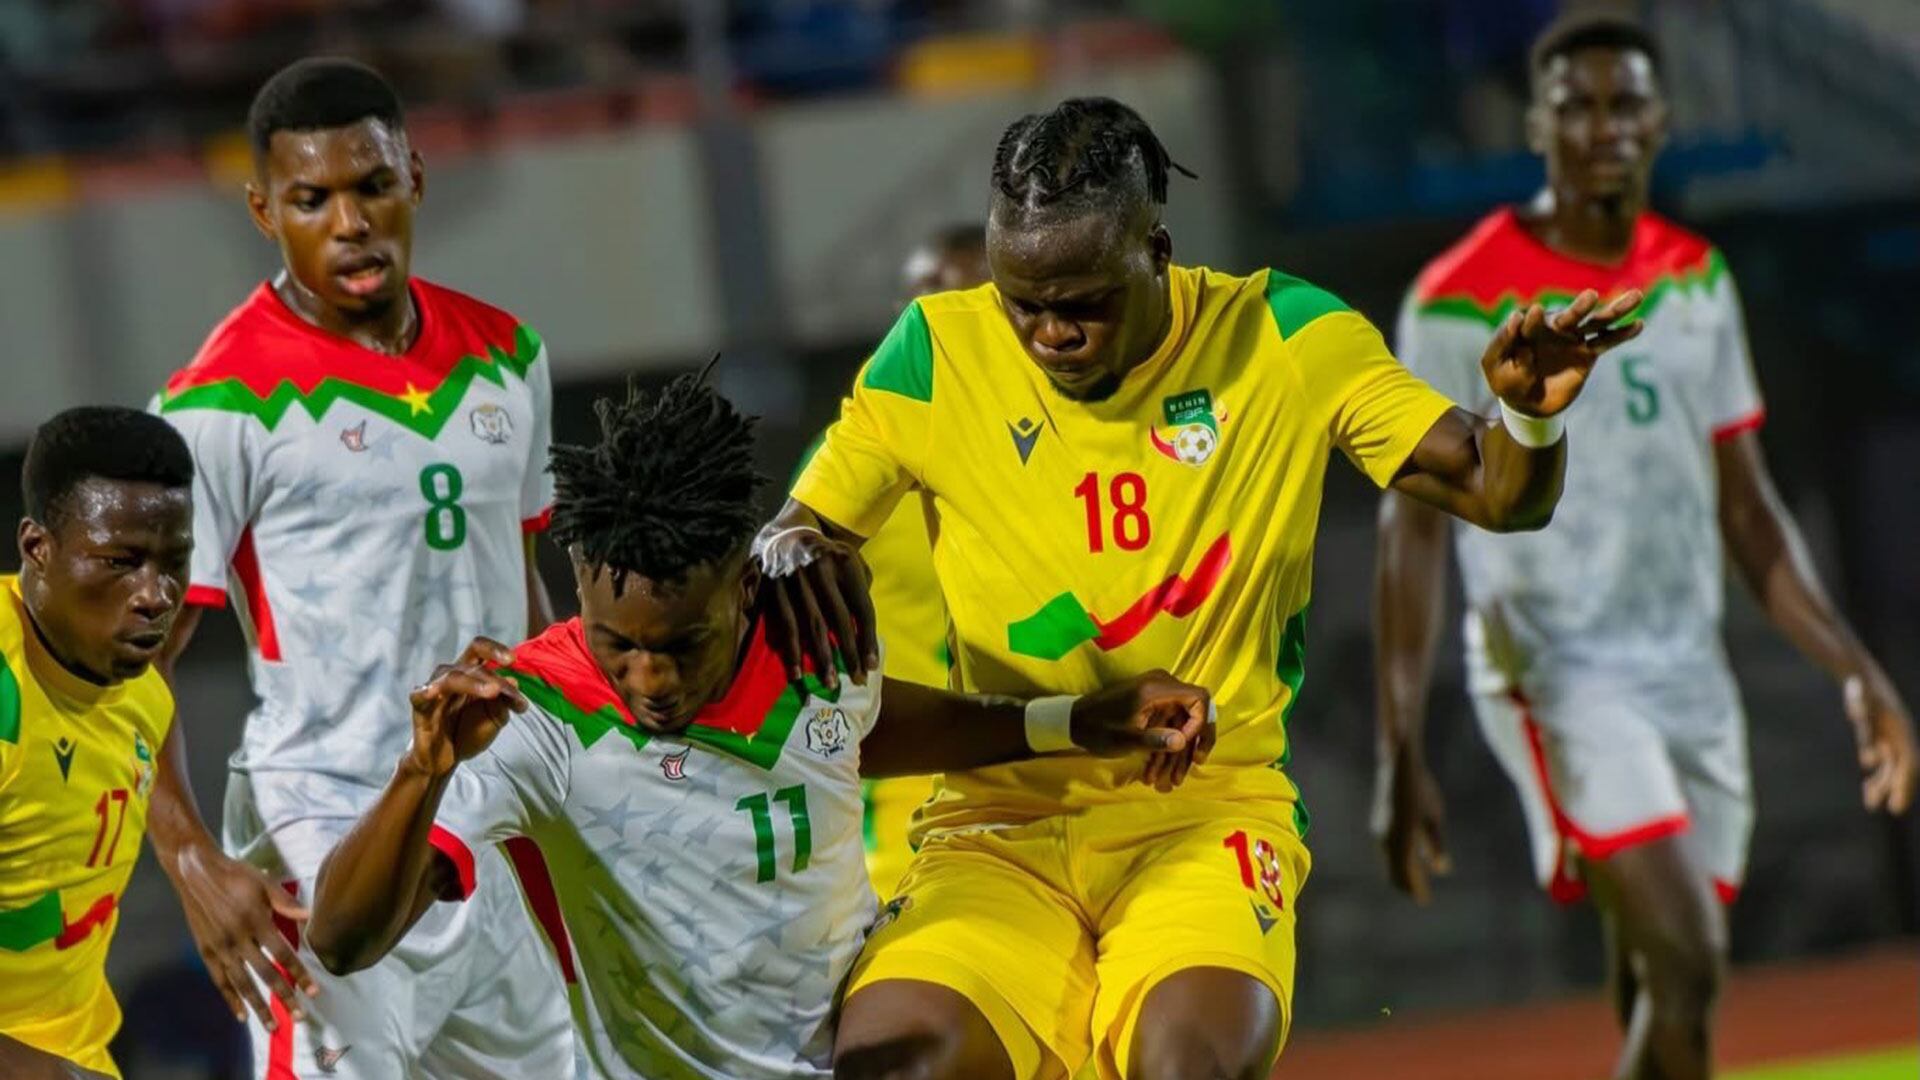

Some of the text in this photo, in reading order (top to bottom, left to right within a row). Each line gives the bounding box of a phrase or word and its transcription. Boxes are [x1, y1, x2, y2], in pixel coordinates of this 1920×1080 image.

[1621, 355, 1659, 427] 5
[419, 463, 466, 550] 8
[1074, 471, 1151, 553] 18
[86, 789, 128, 868] 17
[735, 784, 812, 884] 11
[1223, 829, 1284, 912] 18
